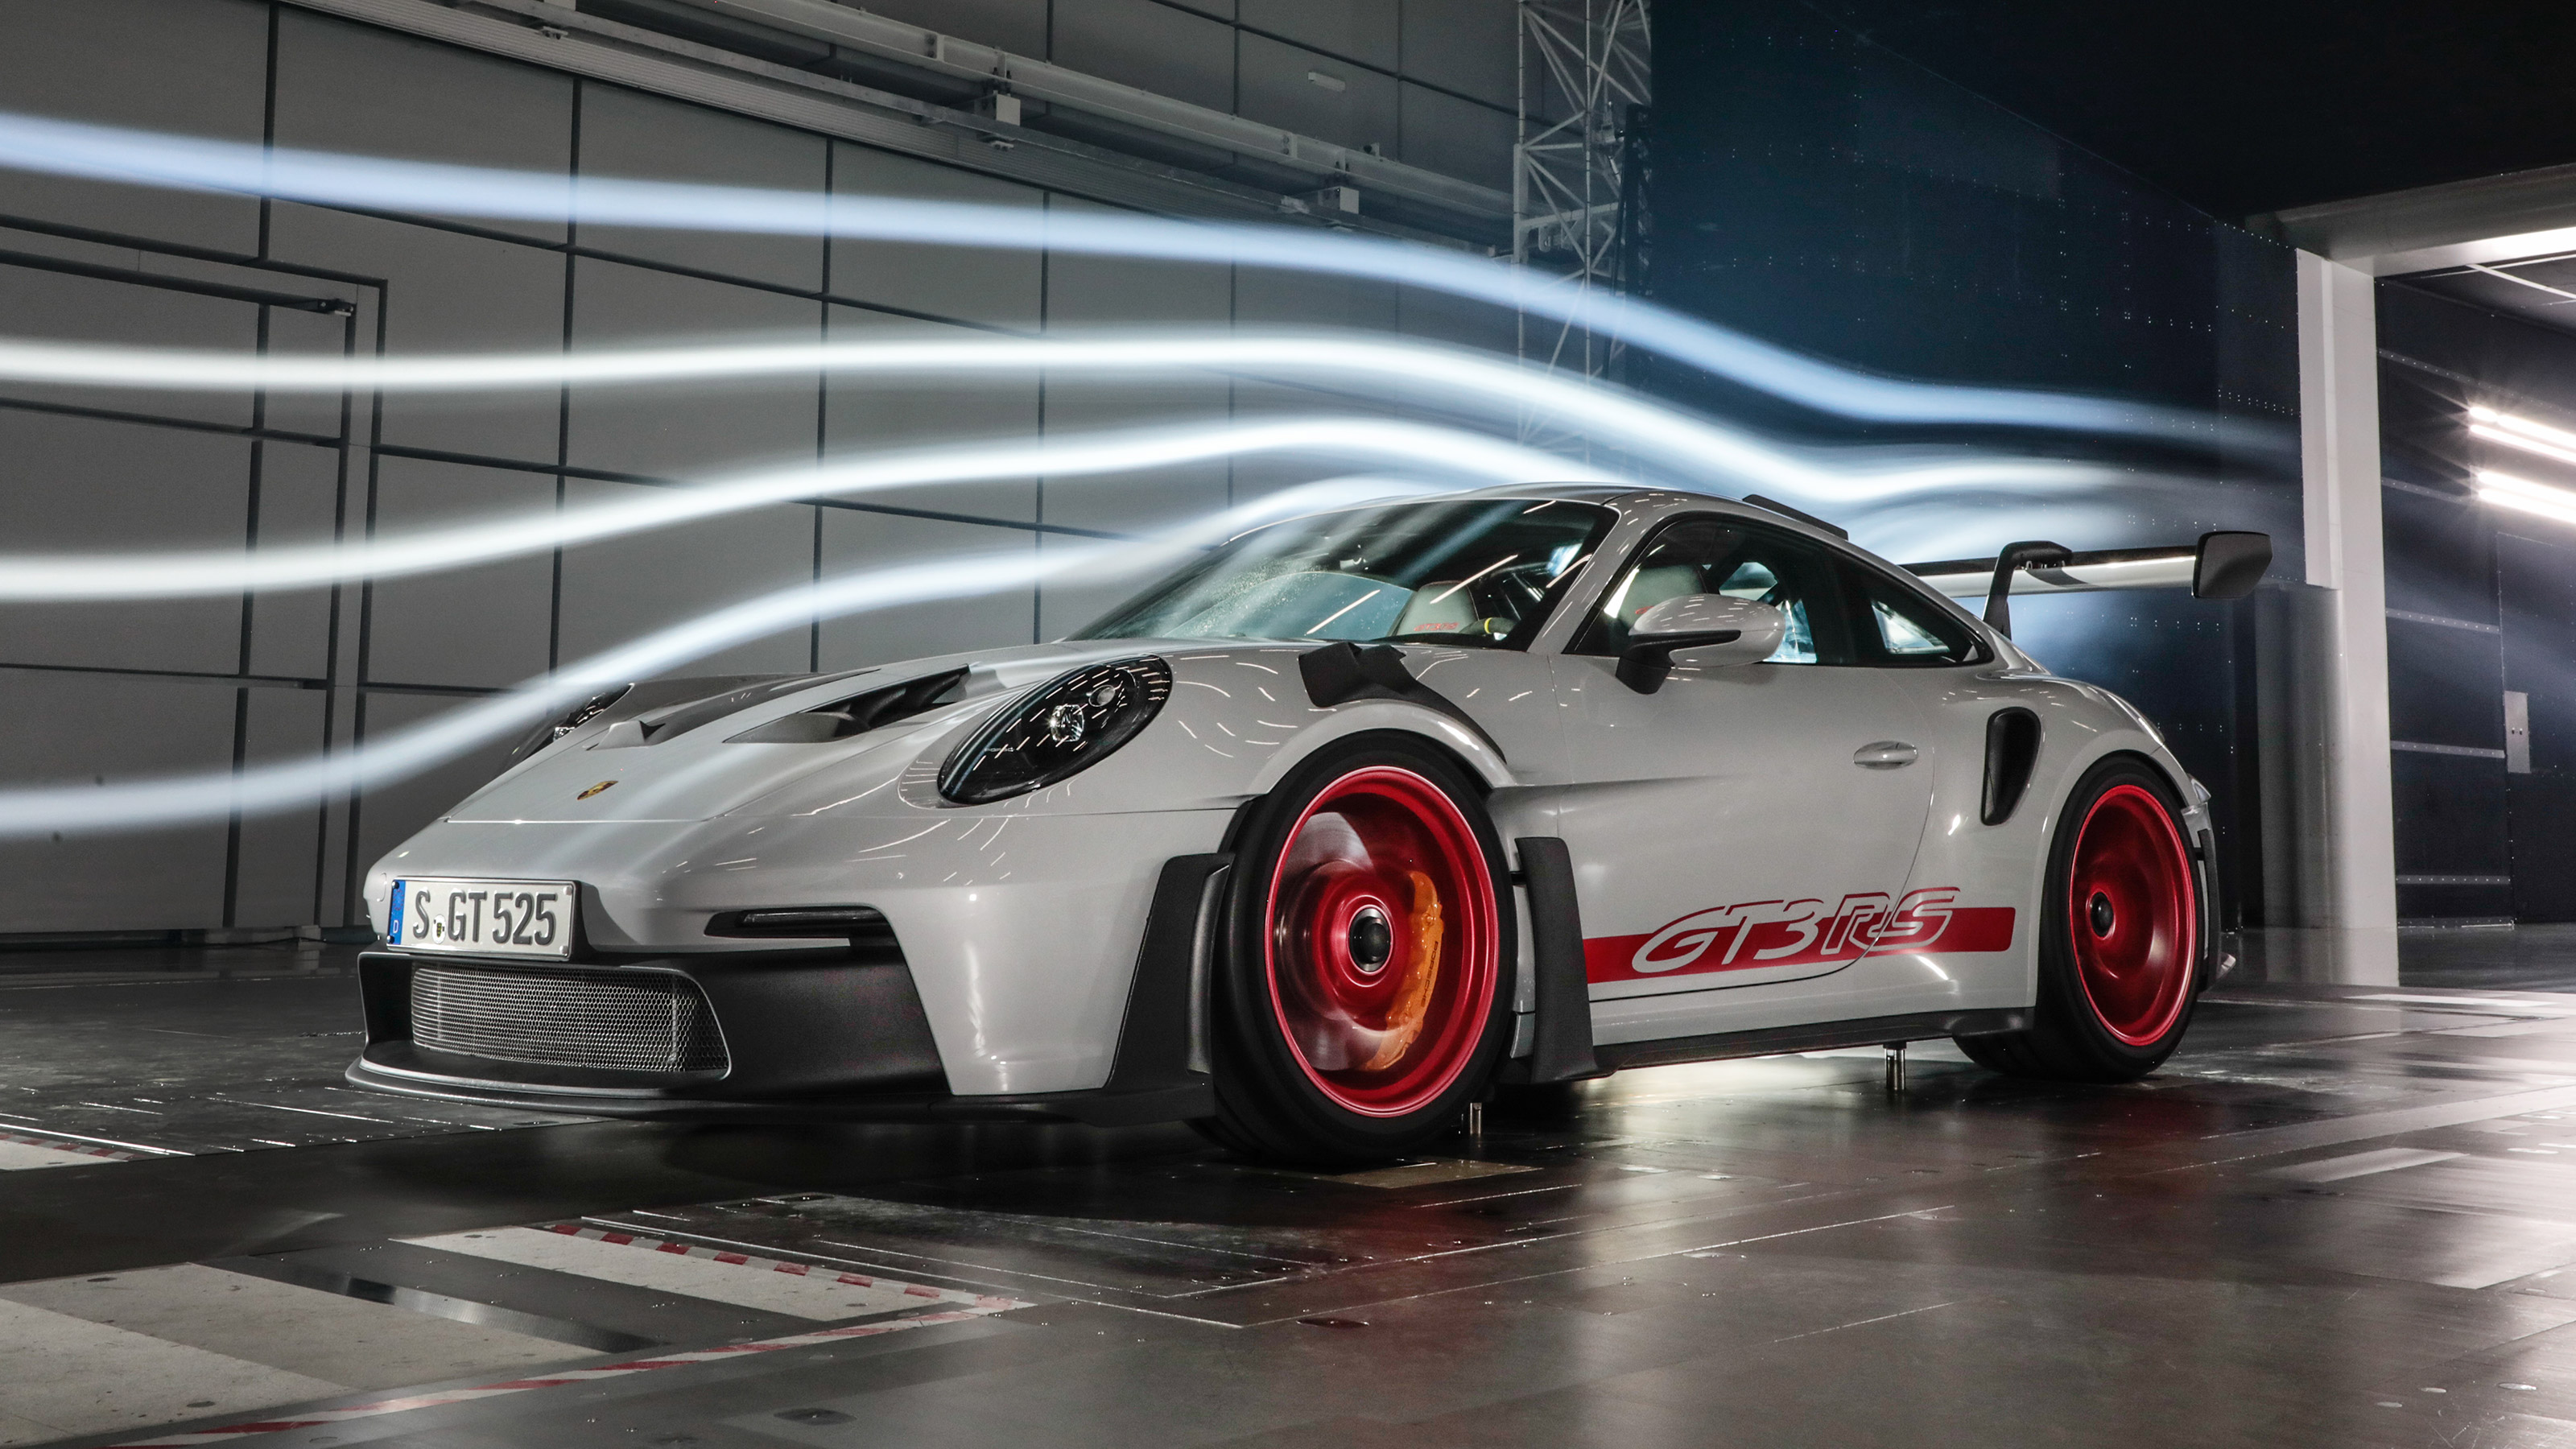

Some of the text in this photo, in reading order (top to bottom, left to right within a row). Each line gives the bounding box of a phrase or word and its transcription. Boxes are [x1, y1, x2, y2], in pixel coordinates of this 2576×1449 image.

[393, 919, 399, 934] D
[413, 887, 559, 946] S GT 525
